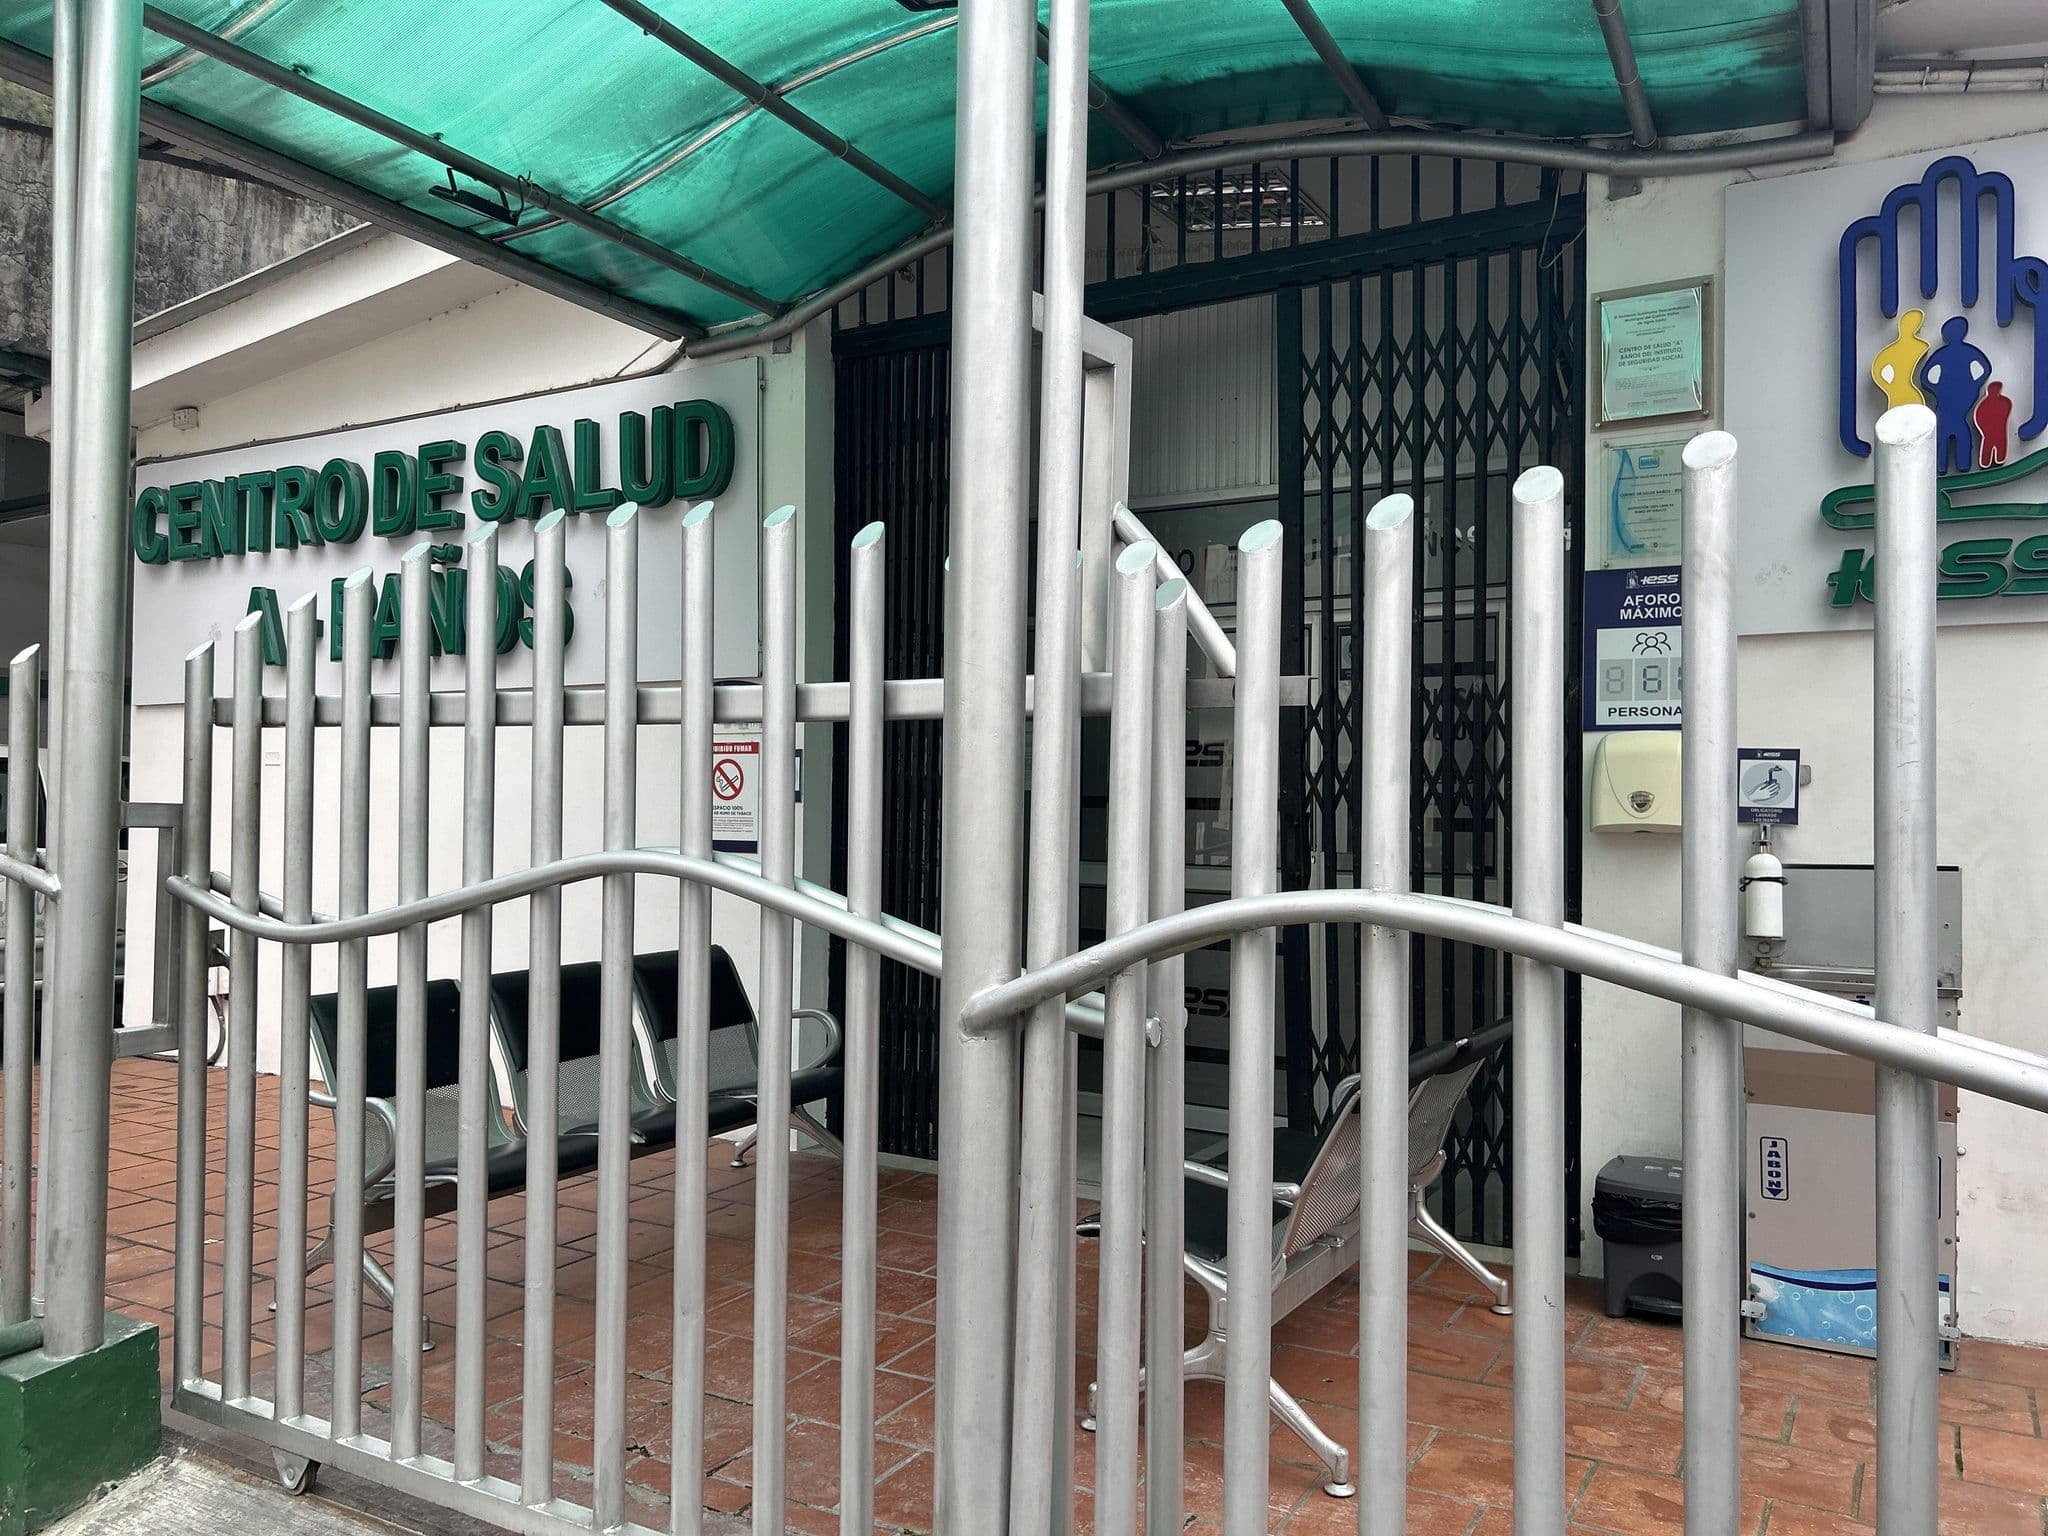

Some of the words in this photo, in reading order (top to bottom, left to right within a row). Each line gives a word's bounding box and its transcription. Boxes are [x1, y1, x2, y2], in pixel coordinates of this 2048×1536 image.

[1619, 345, 1642, 353] CENTRO
[1654, 347, 1682, 355] INSTITUTO
[1627, 357, 1660, 365] SEGURIDAD
[133, 457, 367, 564] CENTRO
[373, 440, 466, 538] DE
[472, 400, 735, 522] SALUD
[247, 543, 575, 667] AAÑOS
[1624, 592, 1681, 607] AFORO
[1620, 605, 1682, 620] MÁXIMO
[1608, 706, 1682, 717] PERSONA
[734, 744, 752, 752] FUMAR
[1766, 1140, 1782, 1188] JABON
